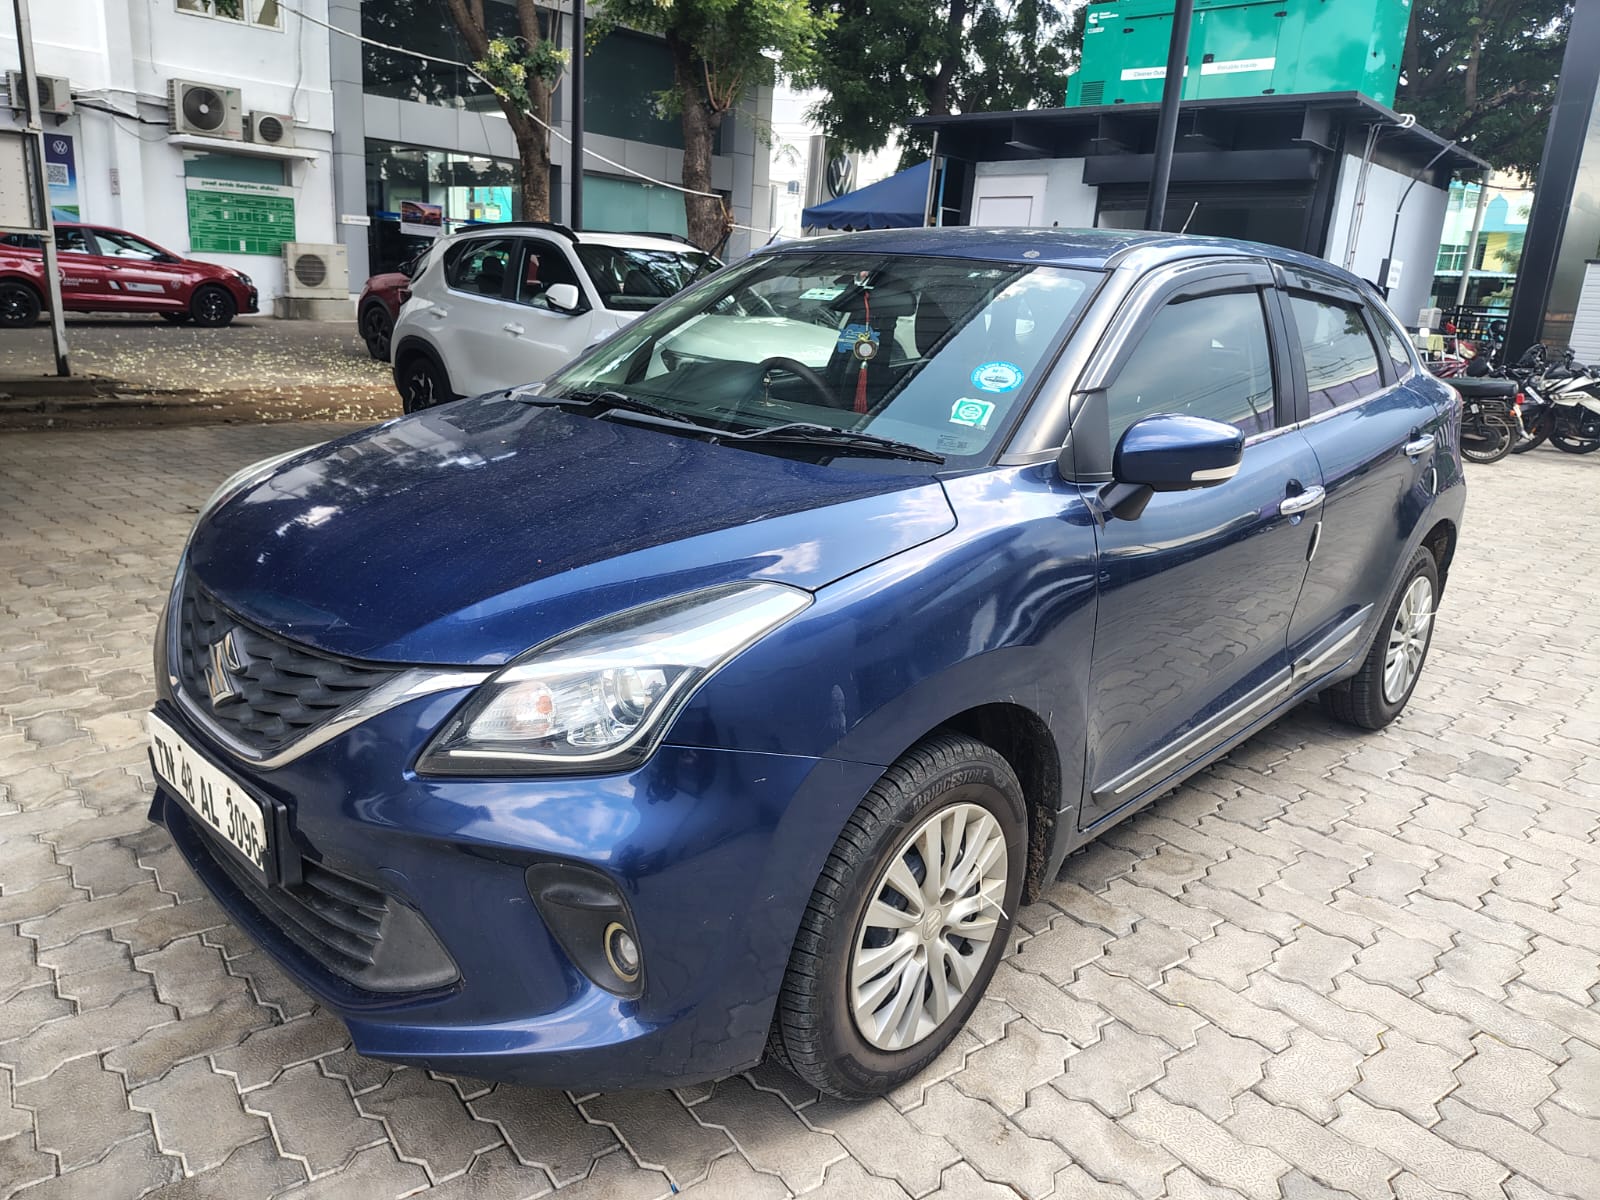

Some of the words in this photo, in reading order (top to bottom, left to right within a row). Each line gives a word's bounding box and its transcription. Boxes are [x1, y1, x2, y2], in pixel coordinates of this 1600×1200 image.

[154, 734, 176, 786] TN
[180, 756, 195, 804] 48
[200, 776, 220, 829] AL
[226, 796, 264, 867] 3096
[911, 768, 988, 812] BRIDGESTONE
